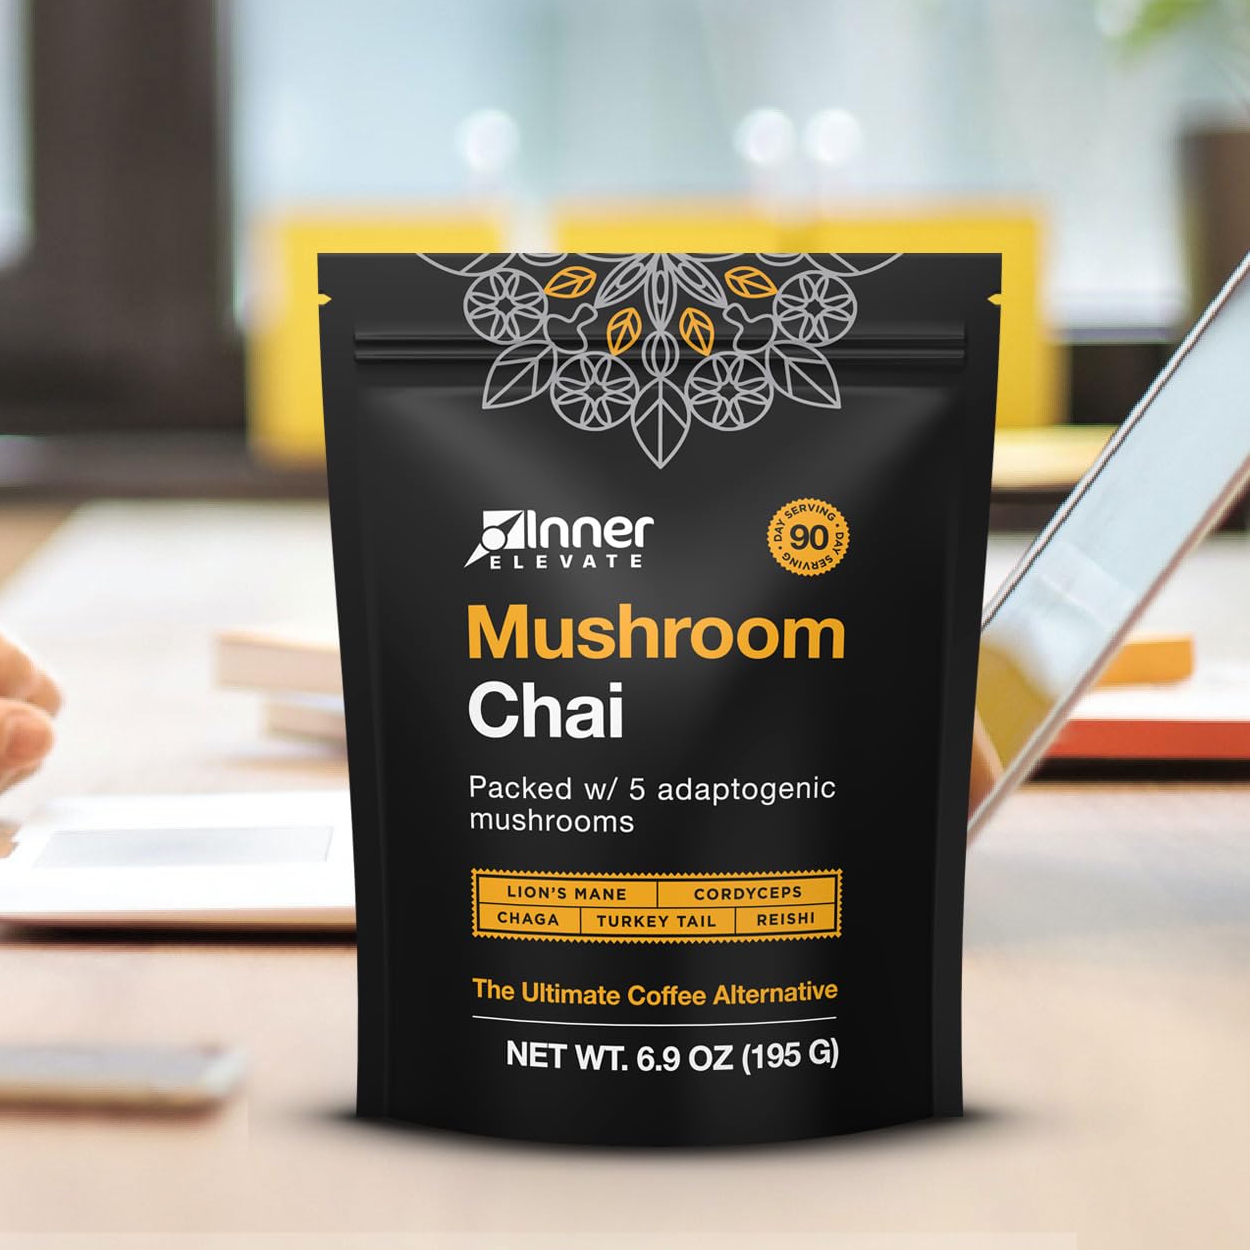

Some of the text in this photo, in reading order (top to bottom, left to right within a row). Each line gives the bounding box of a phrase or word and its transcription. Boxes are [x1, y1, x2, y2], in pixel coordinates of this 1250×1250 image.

[526, 510, 654, 549] Inner
[774, 504, 836, 542] DAY SERVING
[790, 524, 829, 550] 90
[490, 555, 642, 569] ELEVATE
[782, 532, 844, 570] DAY SERVING
[468, 603, 844, 659] Mushroom
[469, 681, 622, 738] Chai
[469, 775, 836, 807] Packed w/ 5 adaptogenic
[470, 808, 634, 833] mushrooms
[506, 885, 626, 901] LION'S MANE
[693, 884, 802, 901] CORDYCEPS
[496, 911, 559, 926] CHAGA
[596, 914, 717, 928] TURKEY TAIL
[756, 911, 815, 926] REISHI
[472, 977, 838, 1006] The Ultimate Coffee Alternative
[507, 1036, 839, 1076] NET WT. 6.9 OZ (195 G)
